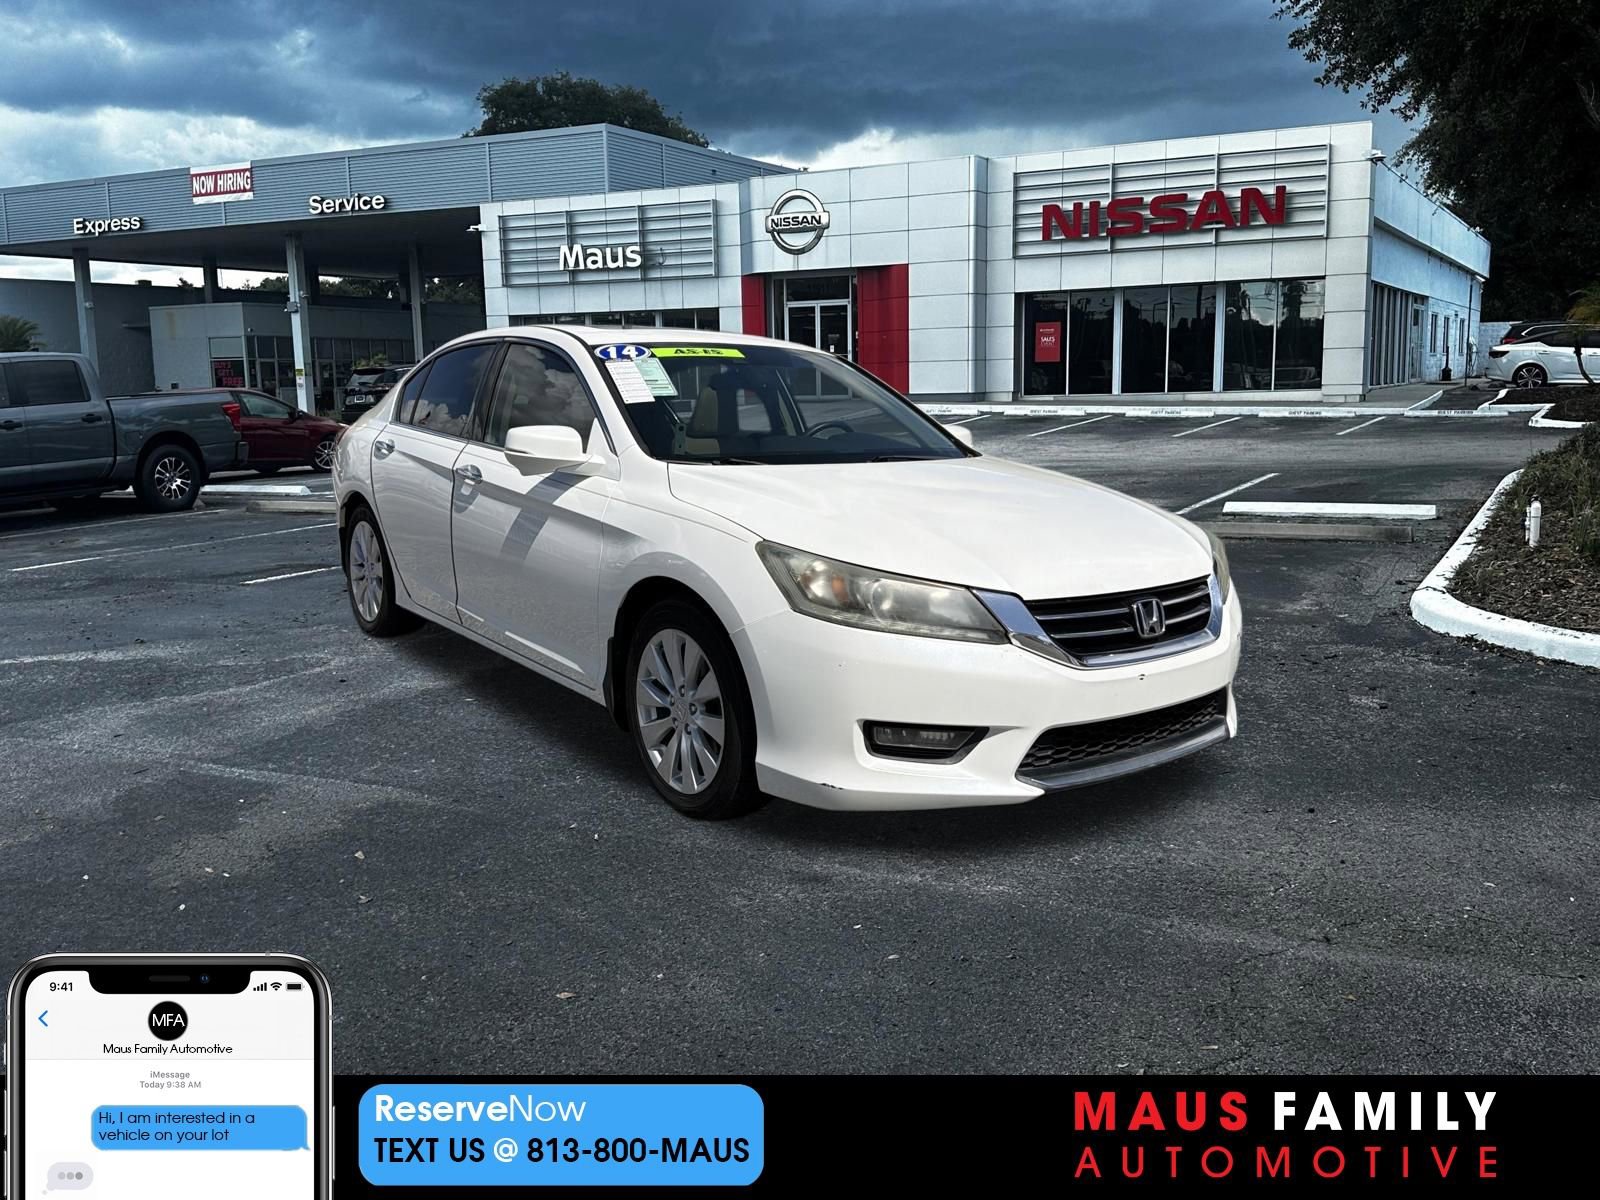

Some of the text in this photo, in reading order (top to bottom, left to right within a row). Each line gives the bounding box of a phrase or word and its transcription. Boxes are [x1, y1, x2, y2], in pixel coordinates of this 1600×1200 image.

[193, 171, 251, 195] NOW HIRING
[309, 193, 385, 214] Service
[1042, 185, 1286, 241] NISSAN
[73, 216, 140, 236] Express
[770, 214, 822, 230] NISSAN
[559, 243, 642, 270] Maus
[607, 346, 638, 358] 14
